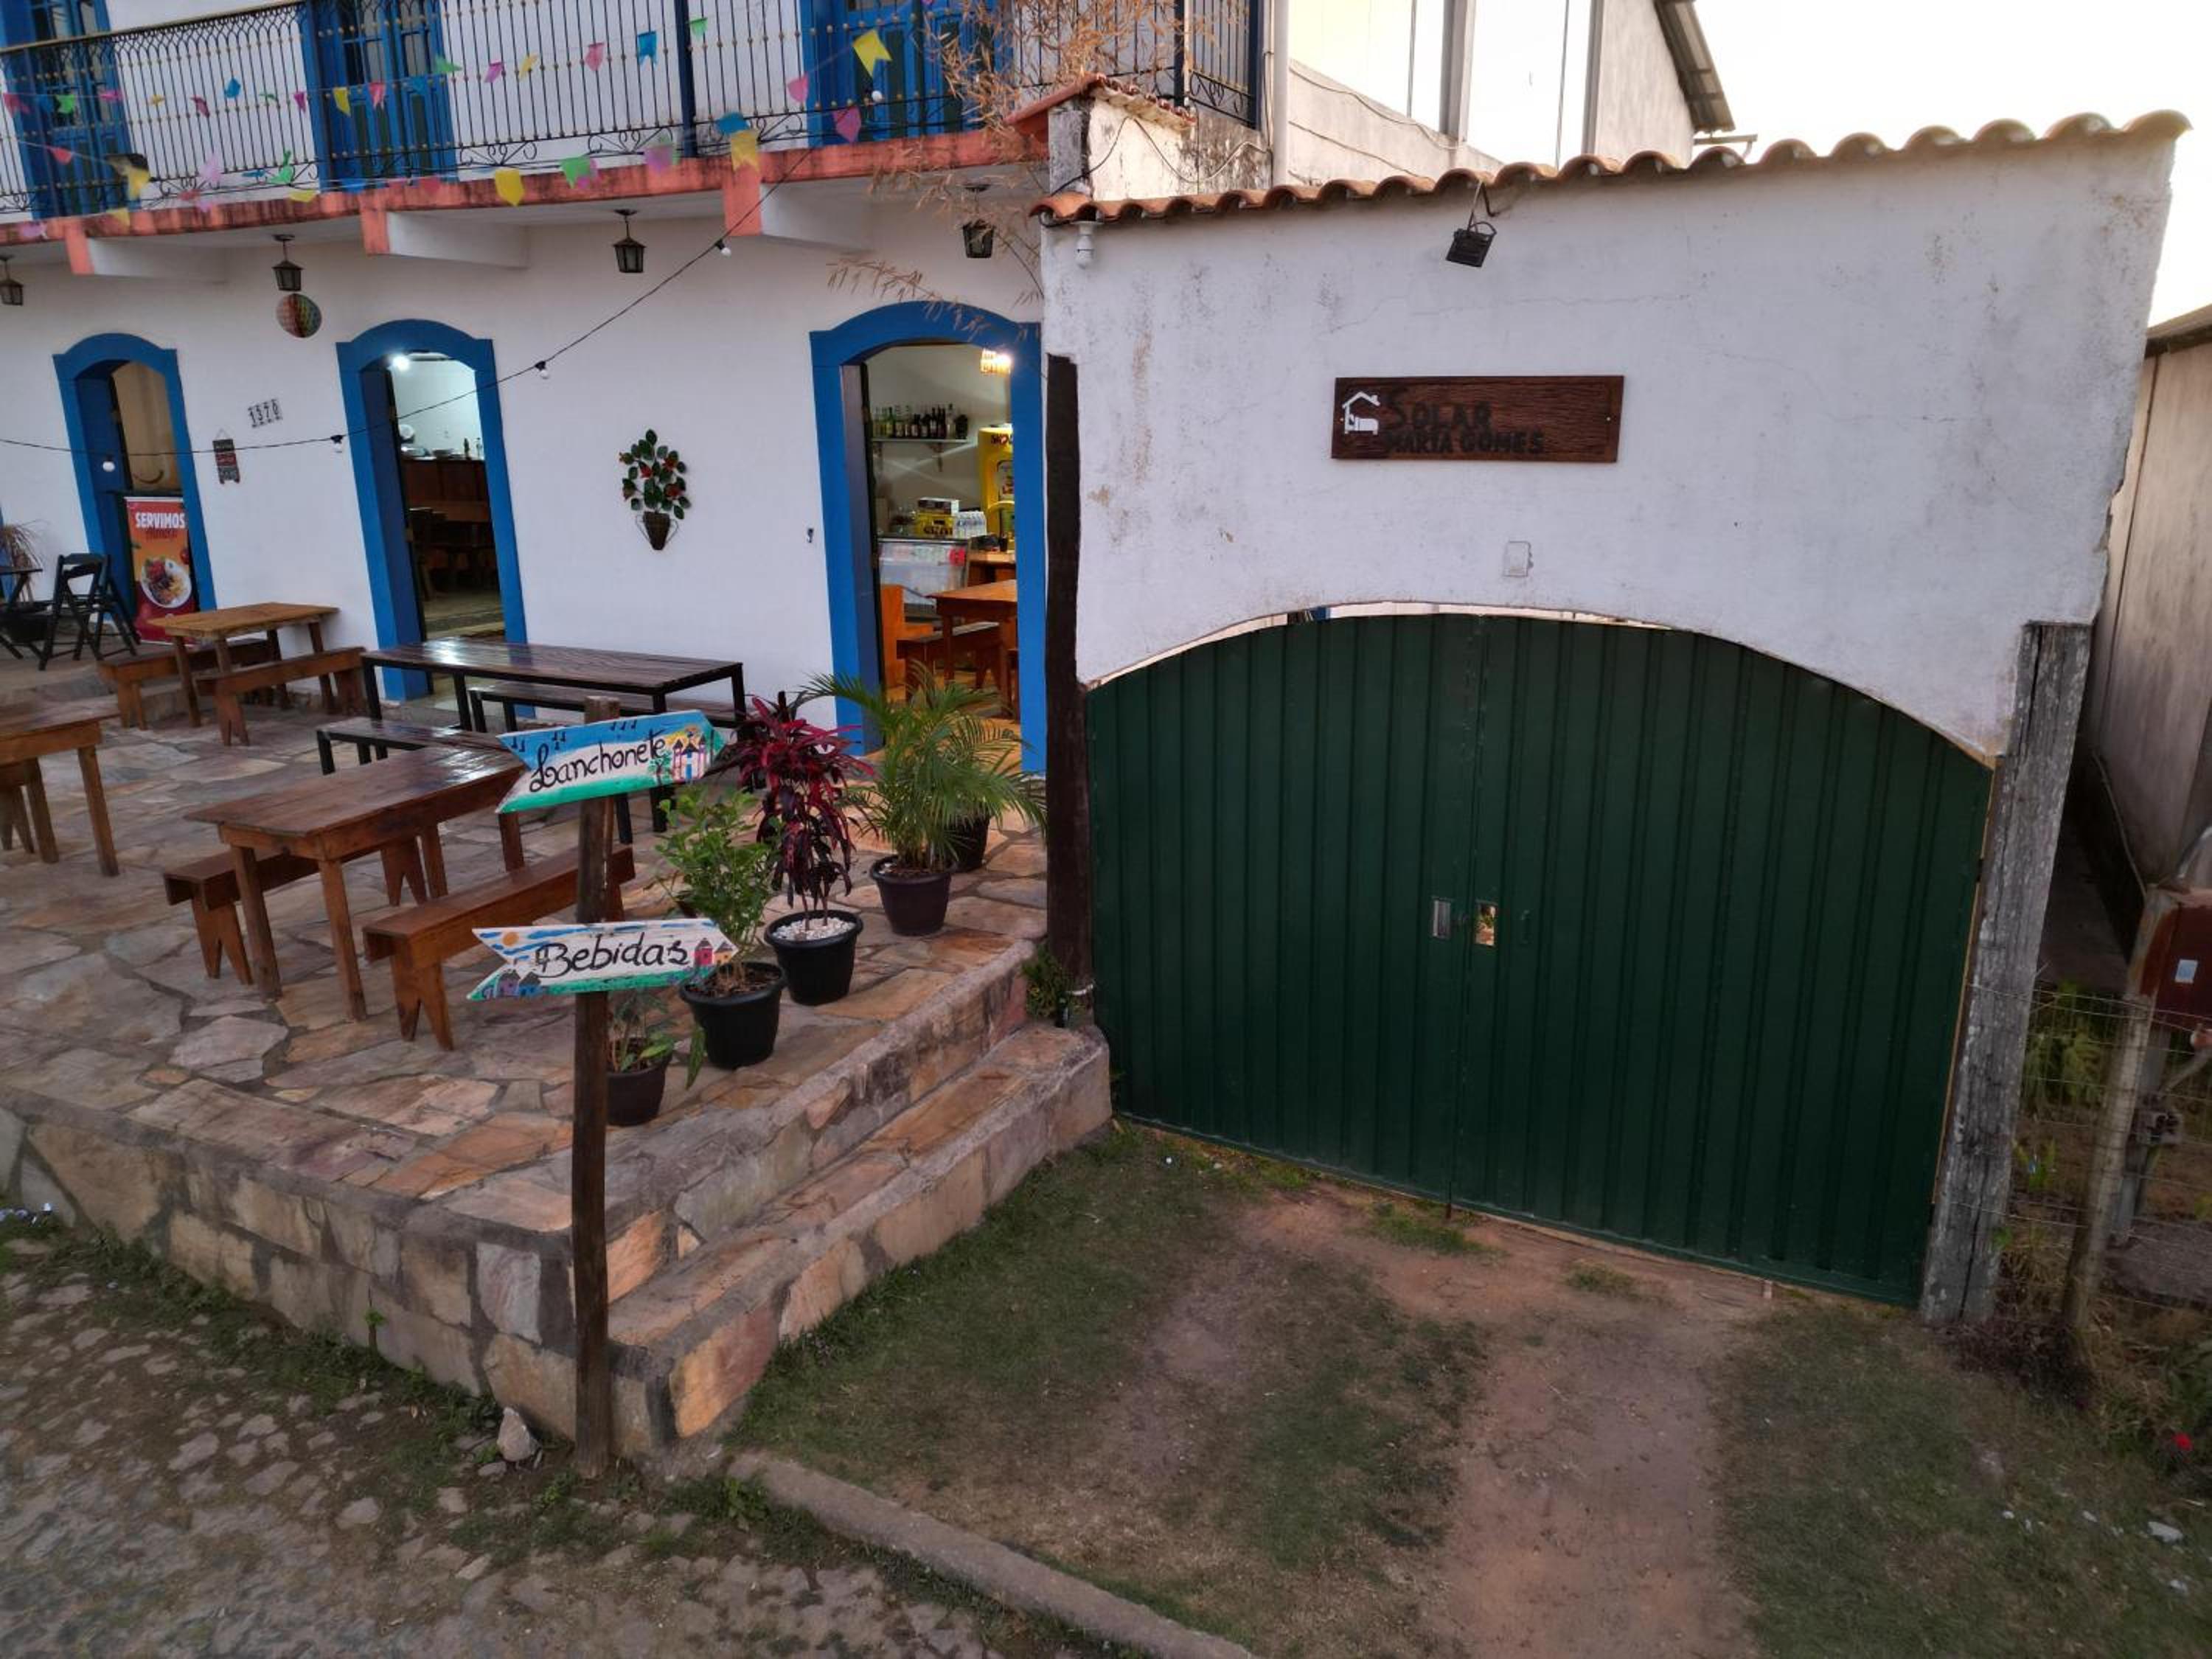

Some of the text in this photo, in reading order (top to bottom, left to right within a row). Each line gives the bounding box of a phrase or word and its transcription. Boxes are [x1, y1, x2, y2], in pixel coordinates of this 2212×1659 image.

[1385, 386, 1492, 430] SOLAR
[1460, 429, 1545, 455] GOMES
[135, 512, 187, 529] SERVIMOS
[529, 728, 667, 793] Lanchonete
[535, 931, 689, 979] Bebidas
